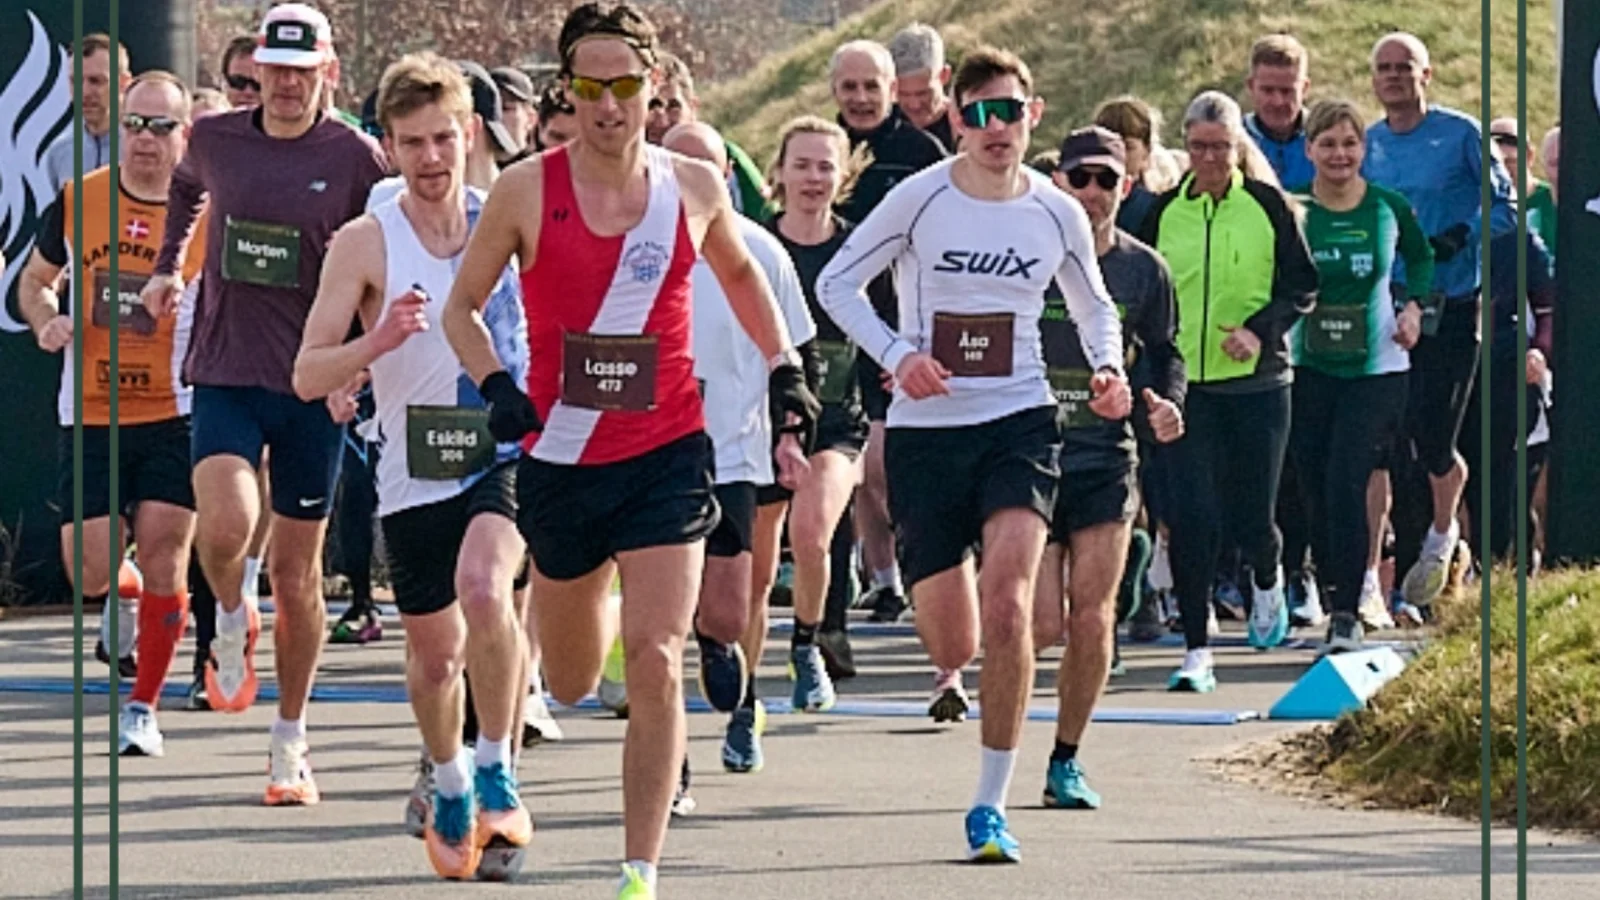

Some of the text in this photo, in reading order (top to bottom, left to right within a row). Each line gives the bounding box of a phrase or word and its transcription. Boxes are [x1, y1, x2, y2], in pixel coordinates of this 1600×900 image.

[237, 238, 289, 260] Morten
[958, 330, 989, 348] Åsa
[585, 358, 638, 377] Lasse
[426, 429, 477, 447] Eskild
